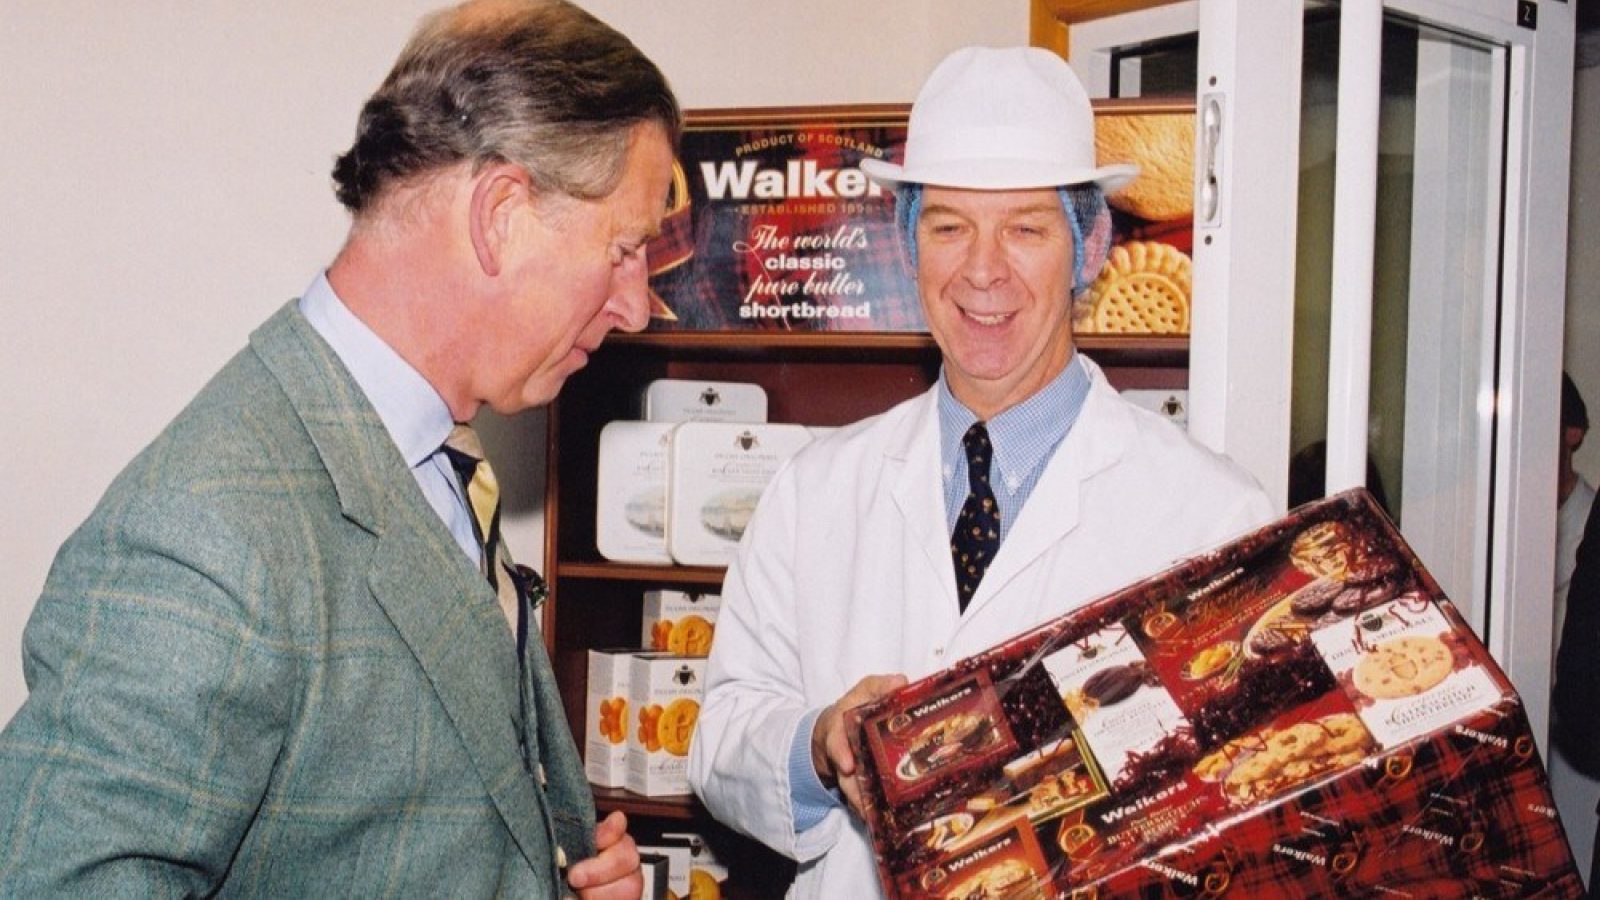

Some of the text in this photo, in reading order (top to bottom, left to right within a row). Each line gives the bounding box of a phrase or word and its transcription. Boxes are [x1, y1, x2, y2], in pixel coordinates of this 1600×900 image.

[736, 134, 883, 158] PRODUCT OF SCOTLAND
[741, 203, 836, 215] ESTABLISHED
[794, 225, 868, 251] world's
[765, 253, 846, 271] classic
[744, 272, 866, 303] pure butter
[739, 302, 870, 318] shortbread
[913, 687, 972, 717] Walkers
[1455, 724, 1508, 749] Walkers
[1101, 781, 1188, 824] Walkers
[1402, 824, 1454, 847] Walkers
[949, 838, 1012, 872] Walkers
[1273, 843, 1326, 867] Walkers
